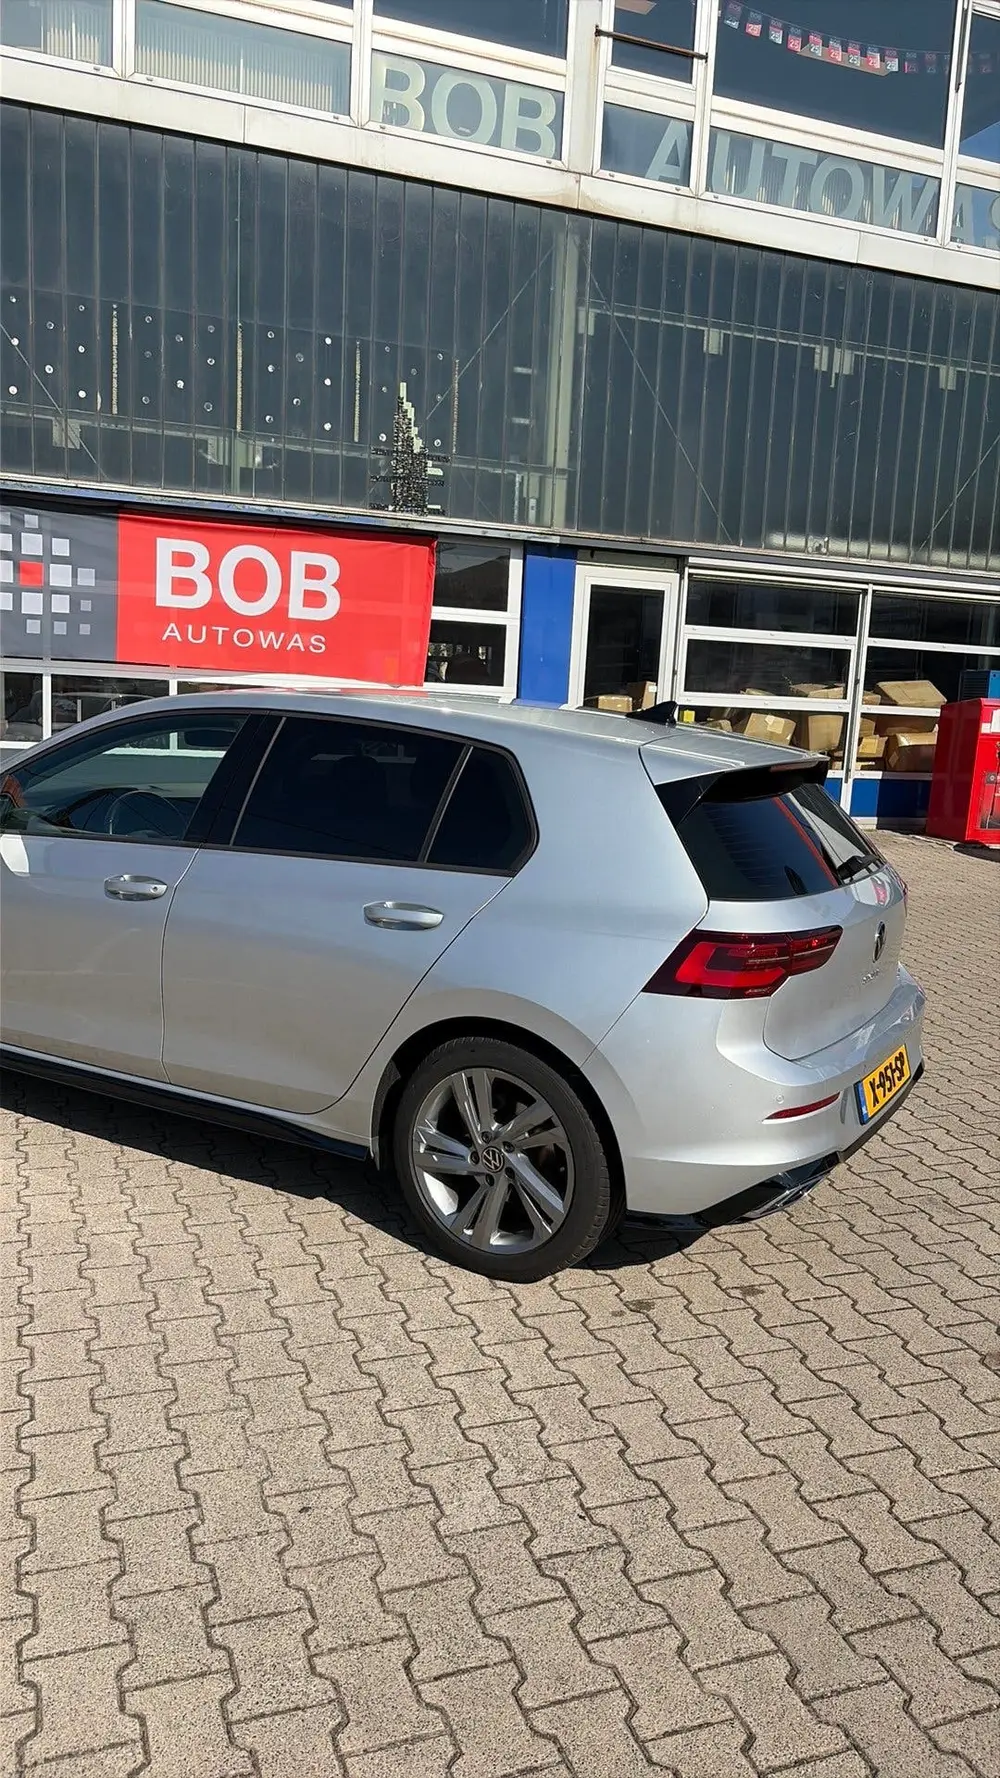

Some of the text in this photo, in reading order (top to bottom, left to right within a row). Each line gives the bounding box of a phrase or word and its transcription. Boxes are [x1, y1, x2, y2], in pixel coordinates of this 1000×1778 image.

[370, 51, 556, 160] BOB
[155, 537, 341, 621] BOB
[162, 622, 327, 653] AUTOWAS
[869, 1052, 905, 1107] X-951-SP
